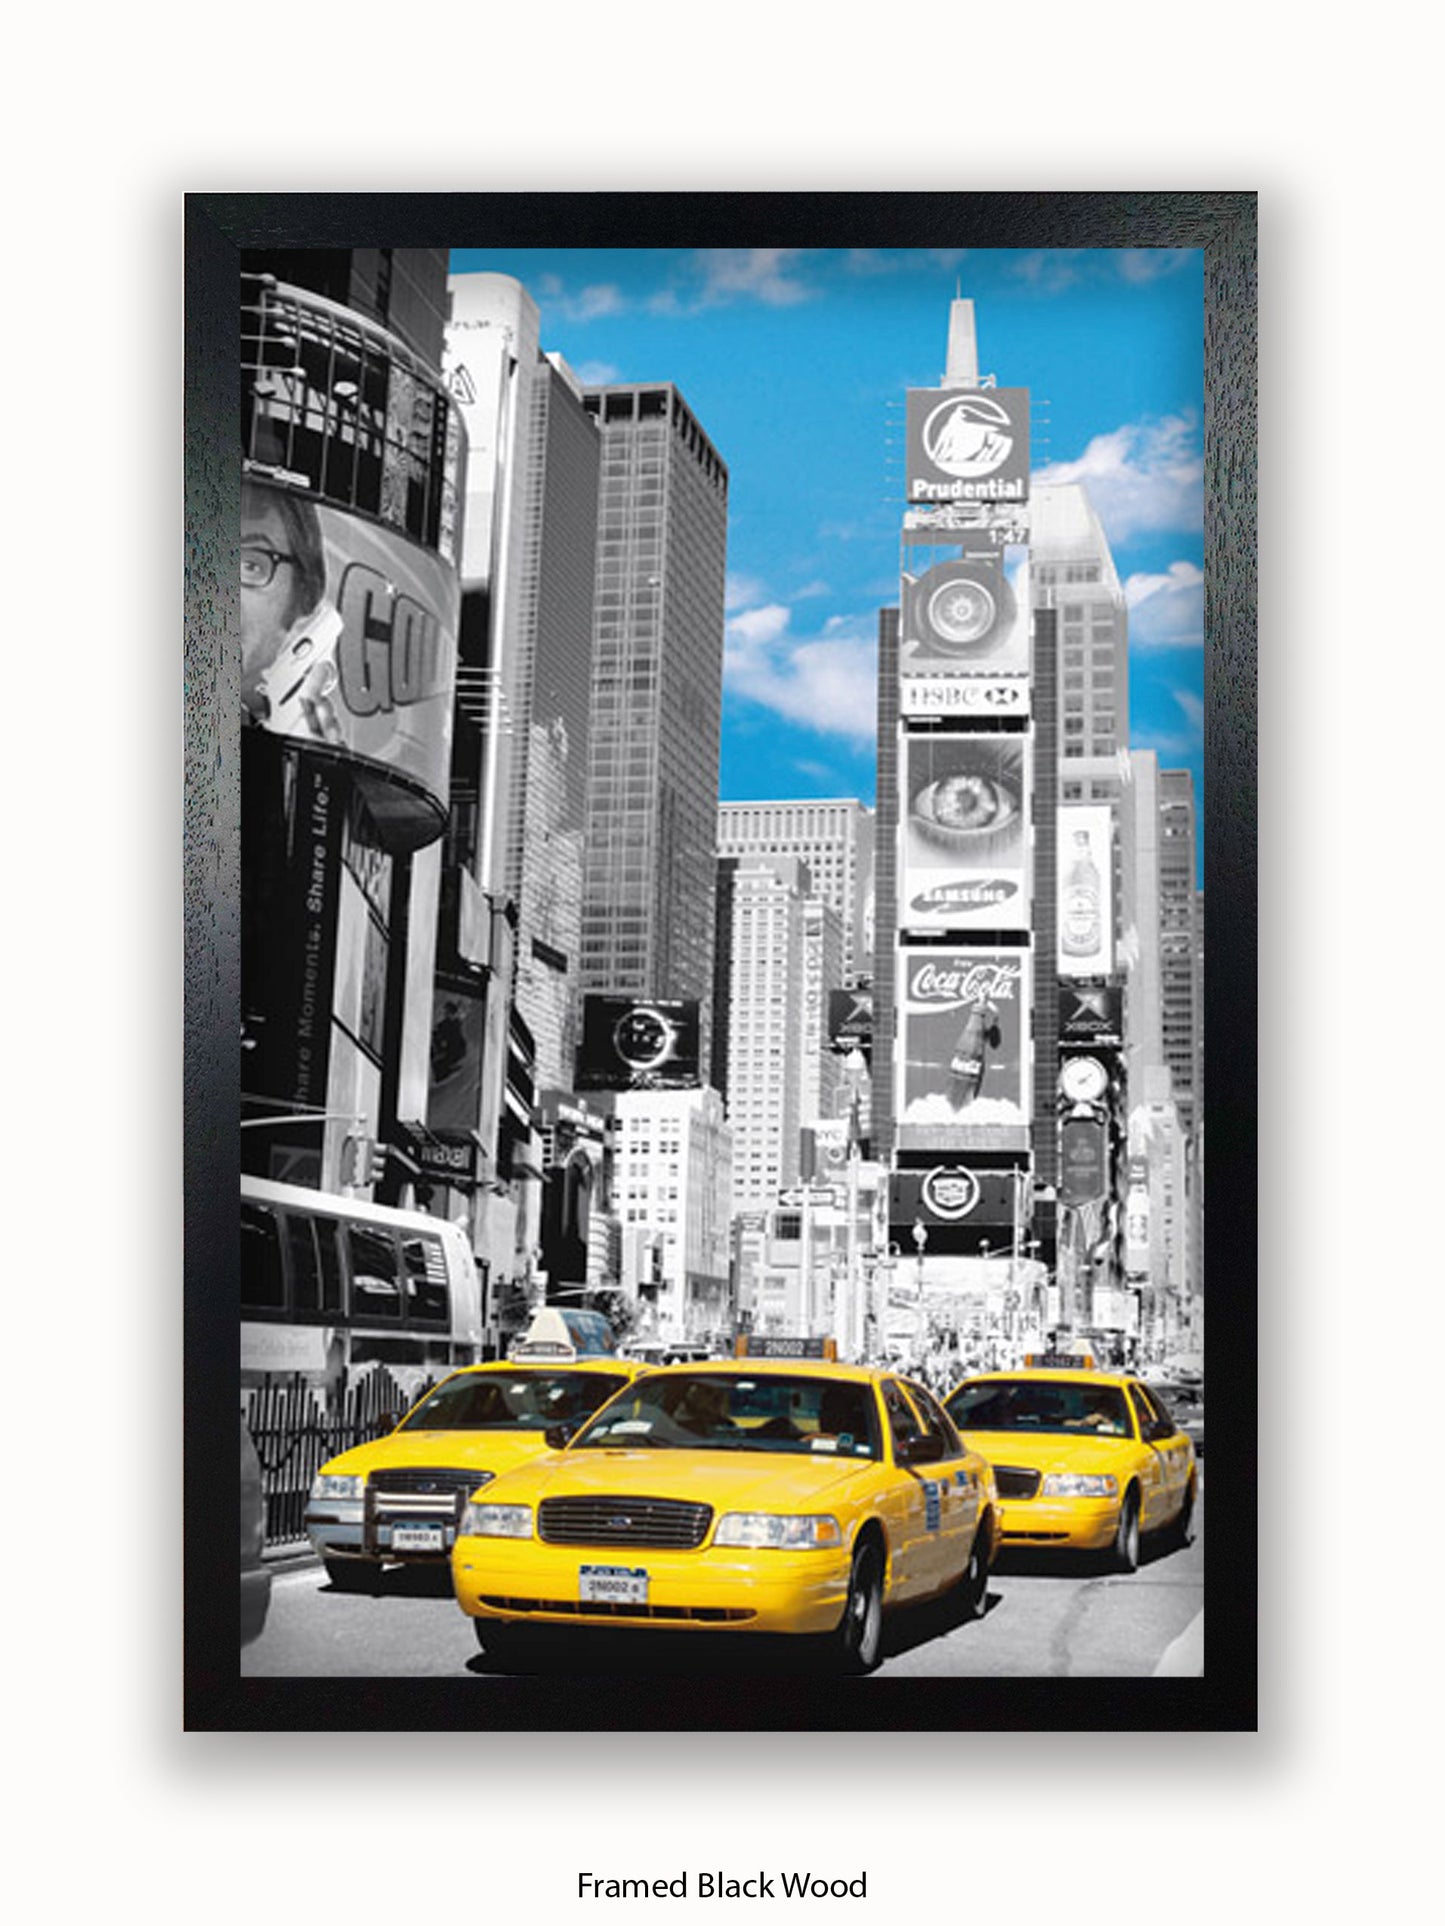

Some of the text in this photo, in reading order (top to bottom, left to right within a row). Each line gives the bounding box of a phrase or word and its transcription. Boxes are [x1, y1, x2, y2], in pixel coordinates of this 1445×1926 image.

[912, 479, 1022, 498] Prudential
[909, 686, 980, 706] HSBC
[305, 845, 327, 913] Share
[922, 889, 1006, 902] SAMSUNG
[1064, 1020, 1114, 1032] XBOX
